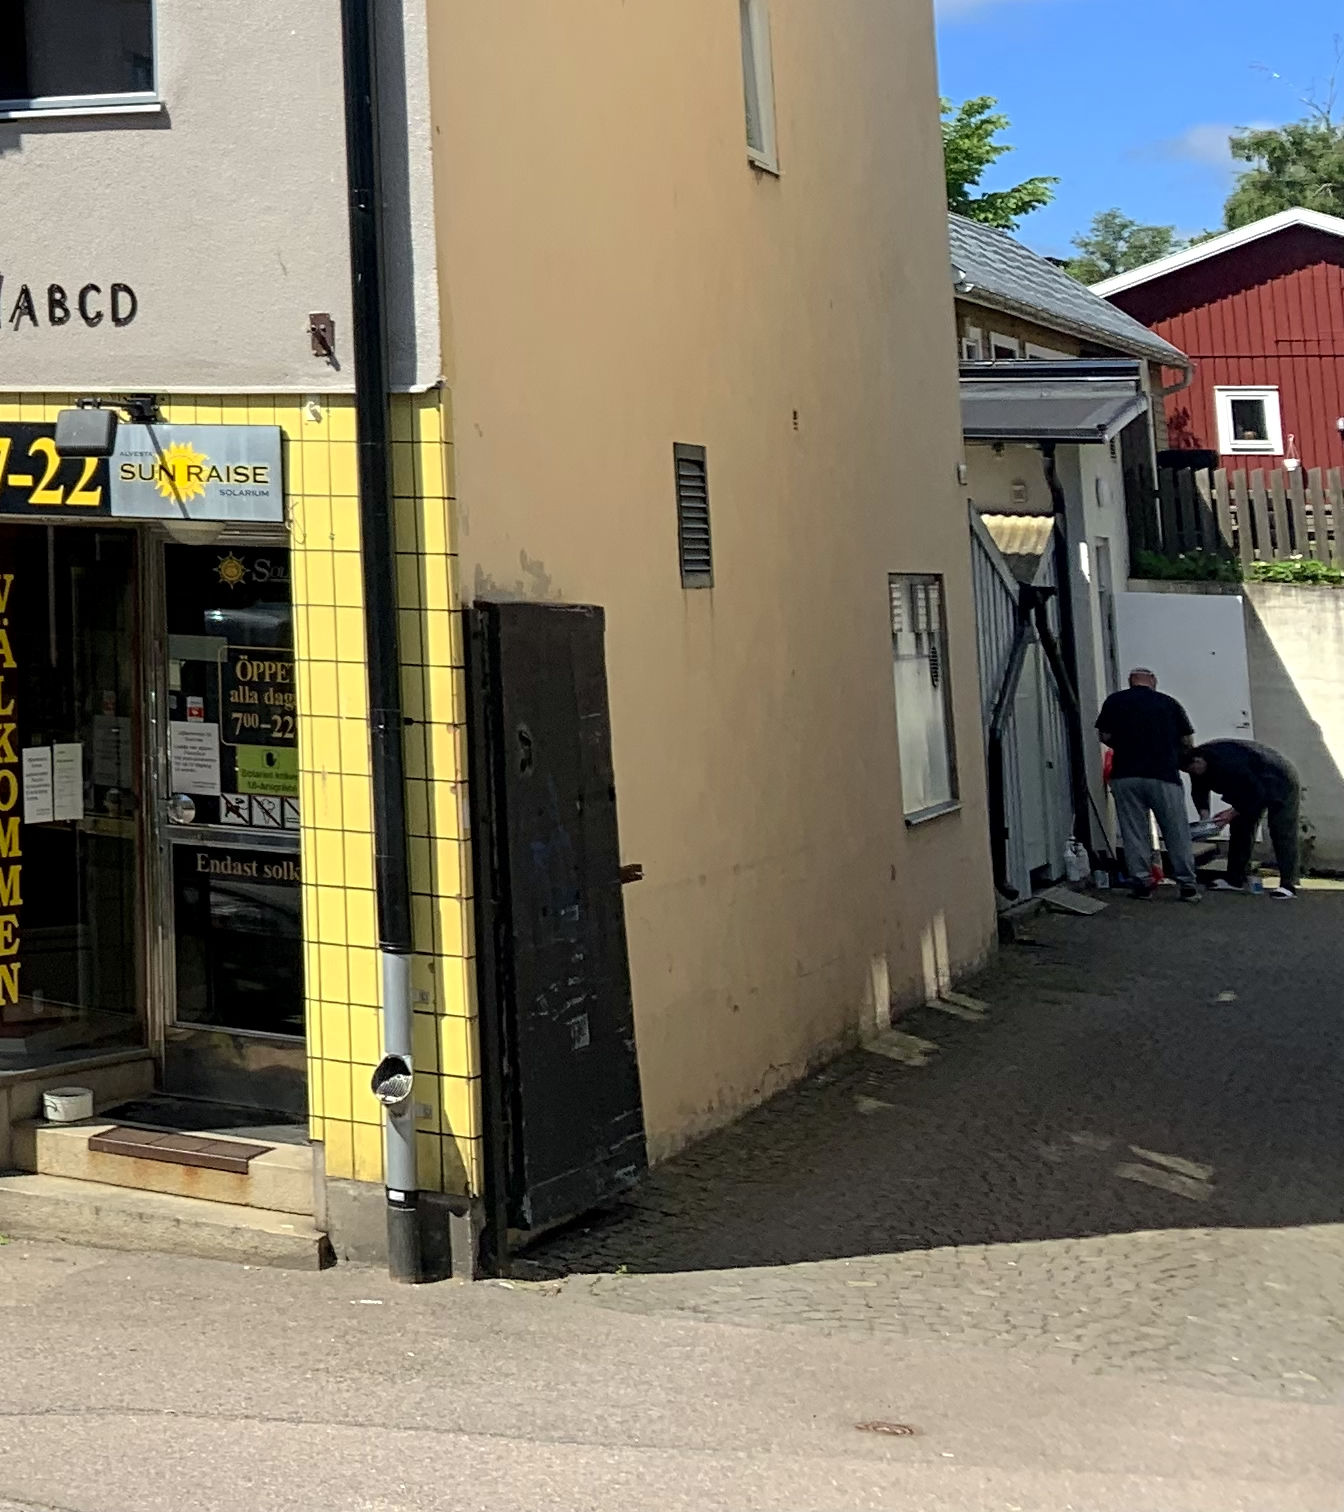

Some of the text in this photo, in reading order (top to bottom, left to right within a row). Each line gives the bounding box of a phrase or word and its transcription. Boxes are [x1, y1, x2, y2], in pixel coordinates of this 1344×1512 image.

[120, 463, 269, 484] SUN RAISE
[219, 489, 270, 497] SOLARIUM
[235, 655, 295, 683] ÖPPE
[230, 686, 259, 704] alla
[196, 853, 258, 877] Endast
